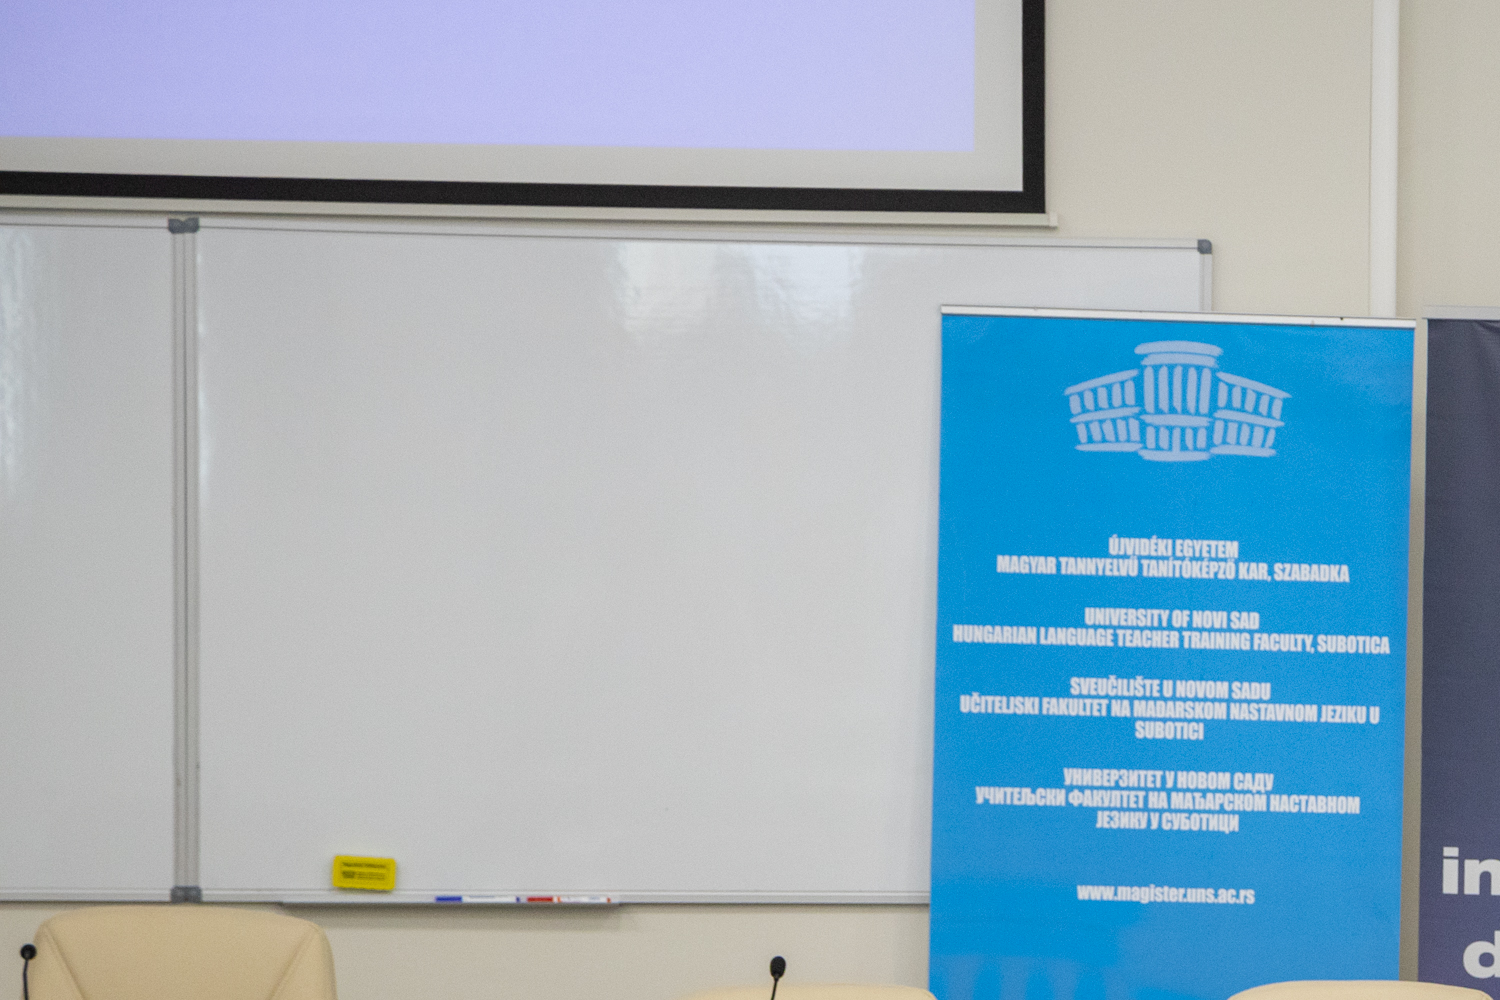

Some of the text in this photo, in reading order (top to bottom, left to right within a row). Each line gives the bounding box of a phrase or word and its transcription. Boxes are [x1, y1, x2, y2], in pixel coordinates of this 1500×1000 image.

[1108, 534, 1239, 559] ÚJVIDÉKI EGYETEM
[996, 554, 1057, 575] MAGYAR
[1238, 561, 1272, 582] KAR,
[1273, 562, 1351, 583] SZABADKA
[1084, 606, 1260, 630] UNIVERSITY OF NOVI SAD
[952, 623, 1391, 655] HUNGARIAN LANGUAGE TEACHER TRAINING FACULTY, SUBOTICA
[1070, 674, 1271, 701] SVEUČILIŠTE U NOVOM SADU
[959, 691, 1040, 715] UČITELJSKI
[1041, 696, 1109, 717] FAKULTET
[1110, 699, 1132, 718] NA
[1229, 702, 1318, 723] NASTAVNOM
[1320, 704, 1367, 725] JEZIKU
[1369, 706, 1380, 725] U
[1134, 720, 1204, 741] SUBOTICI
[1063, 767, 1275, 794] УНИВЕРЗИТЕТ У НОВОМ САДУ
[975, 785, 1361, 815] УЧИТЕЉСКИ ФАКУЛТЕТ НА МАЂАРСКОМ НАСТАВНОМ
[1095, 810, 1240, 834] ЈЕЗИКУ У СУБОТИЦИ
[1076, 883, 1256, 905] www.magister.uns.ac.rs
